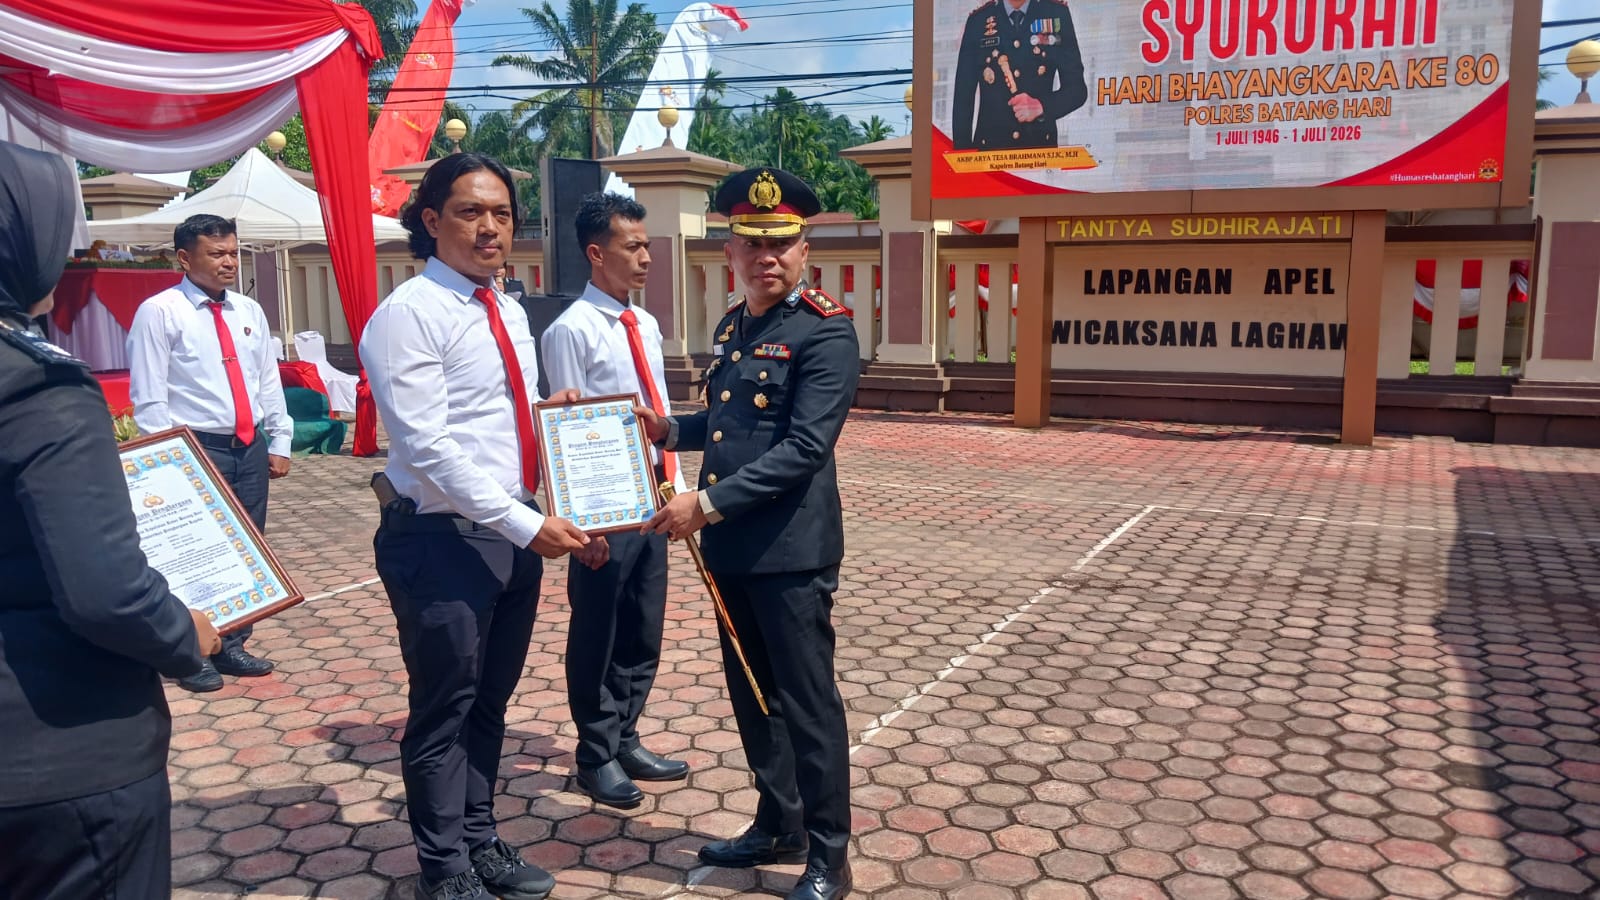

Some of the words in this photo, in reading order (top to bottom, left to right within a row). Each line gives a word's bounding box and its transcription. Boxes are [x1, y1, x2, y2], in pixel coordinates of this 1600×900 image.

[1097, 75, 1161, 106] HARI
[1168, 60, 1400, 102] BHAYANGKARA
[1406, 56, 1448, 89] KE
[1455, 53, 1499, 87] 80
[1184, 104, 1253, 126] POLRES
[1257, 99, 1339, 123] BATANG
[1343, 96, 1392, 118] HARI
[1216, 132, 1221, 145] 1
[1225, 130, 1248, 145] JULI
[1252, 129, 1279, 144] 1946
[1292, 128, 1297, 142] 1
[1301, 126, 1326, 142] JULI
[1331, 125, 1361, 141] 2026
[1009, 152, 1046, 160] BRAHMANA
[1057, 218, 1153, 238] TANTYA
[1170, 216, 1341, 237] SUDHIRAJATI
[1084, 268, 1232, 295] LAPANGAN
[1264, 268, 1335, 294] APEL
[1051, 319, 1217, 347] WICAKSANA
